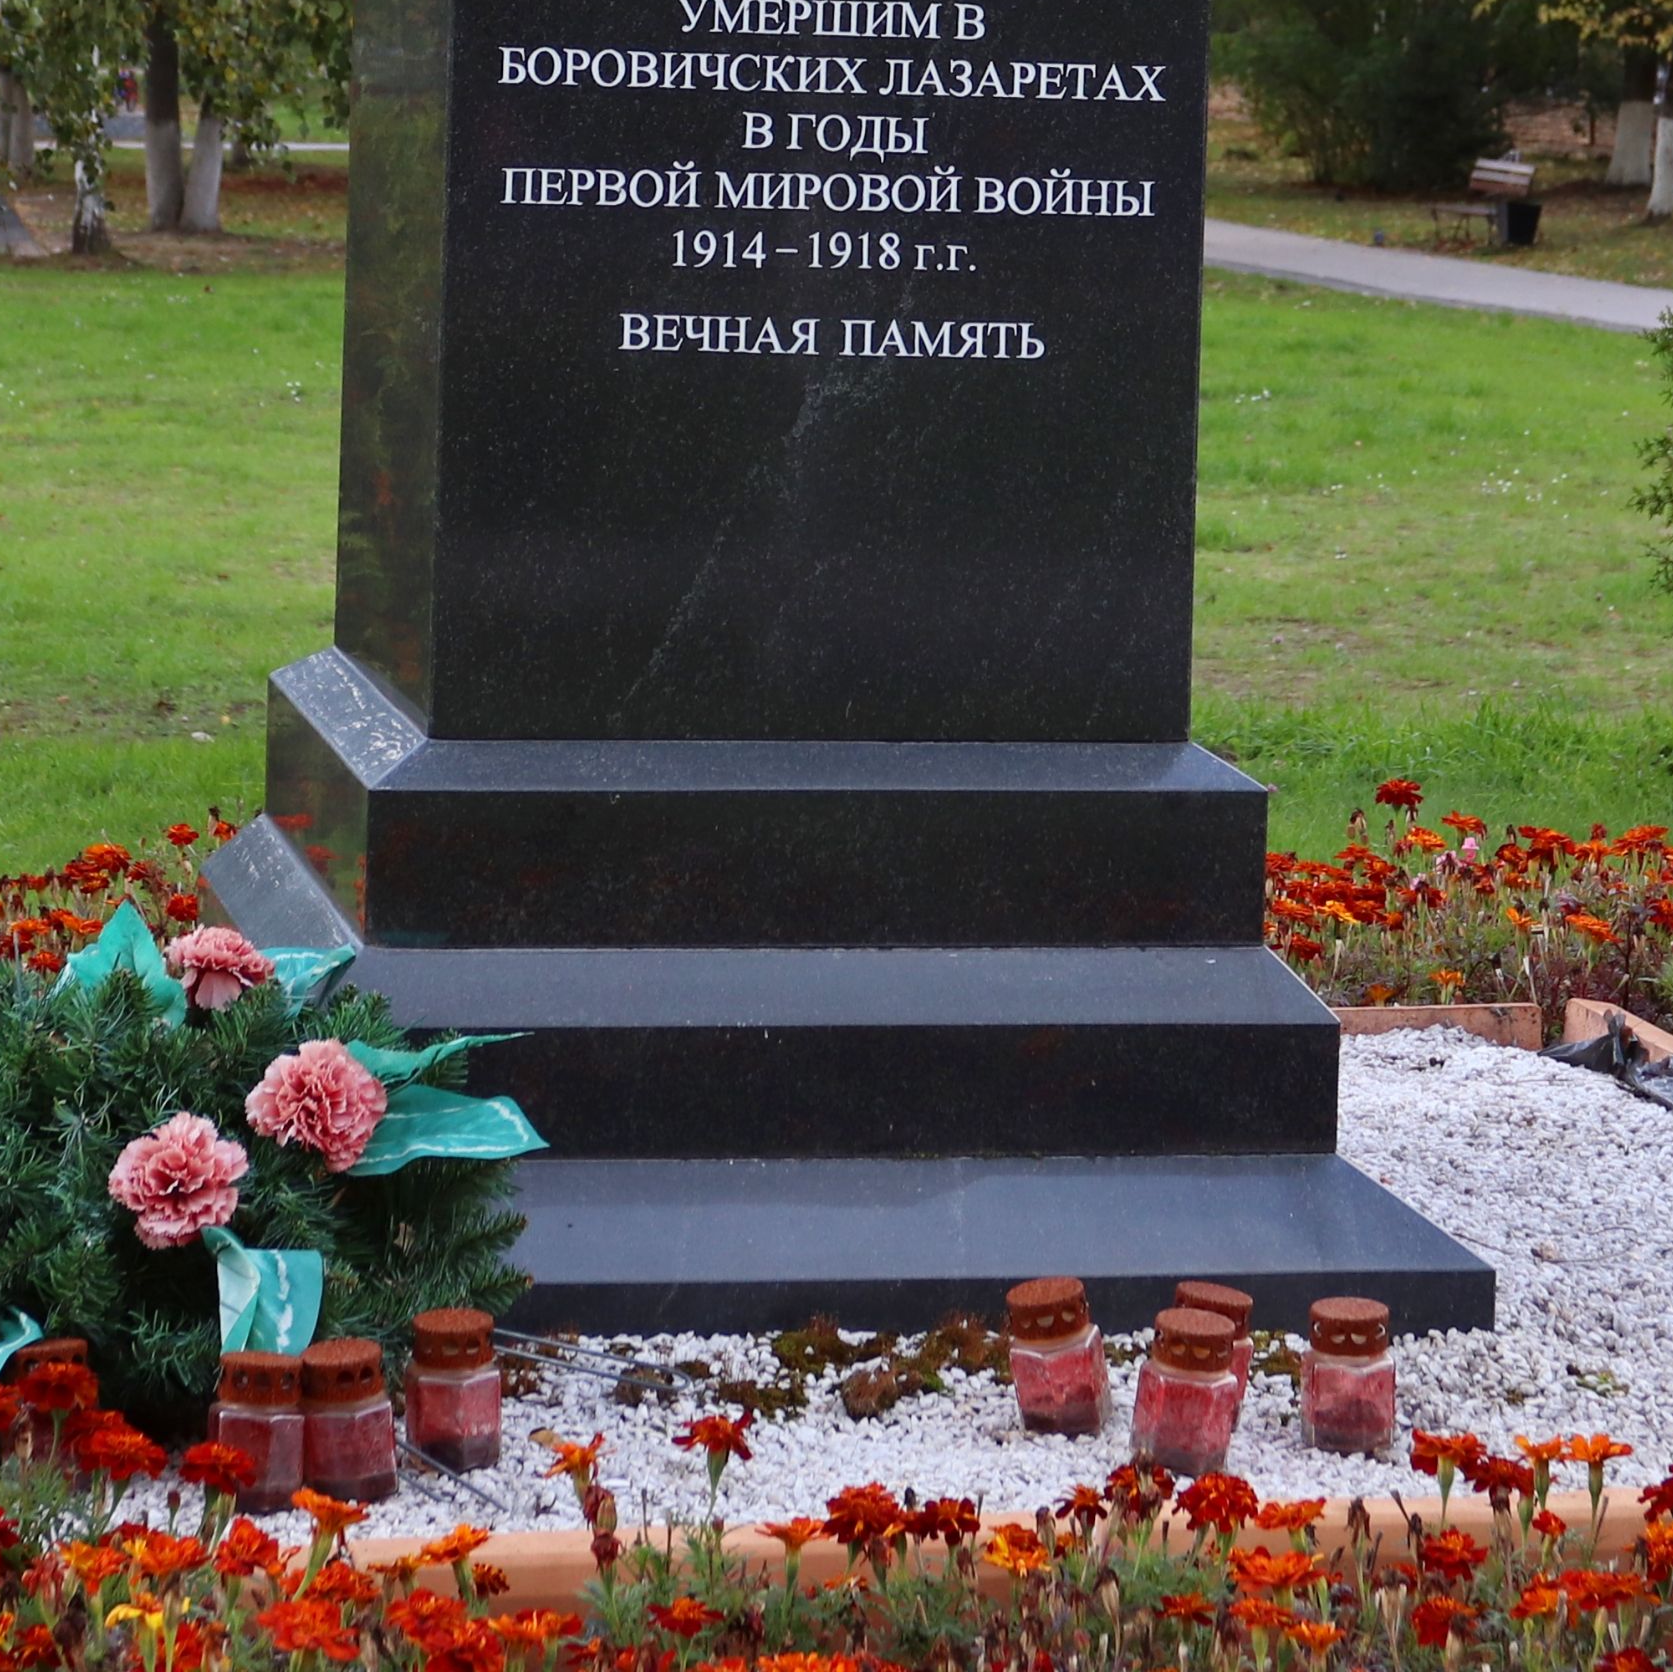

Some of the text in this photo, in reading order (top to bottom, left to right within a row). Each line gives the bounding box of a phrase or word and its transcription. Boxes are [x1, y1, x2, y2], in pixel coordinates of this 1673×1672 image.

[953, 2, 986, 40] В
[497, 46, 1167, 102] БОРОВИЧСКИХ ЛАЗАРЕТАХ
[741, 111, 930, 163] В ГОДЫ
[500, 160, 1156, 217] ПЕРВОЙ МИРОВОЙ ВОЙНЫ
[618, 313, 1045, 359] ВЕЧНАЯ ПАМЯТЬ
